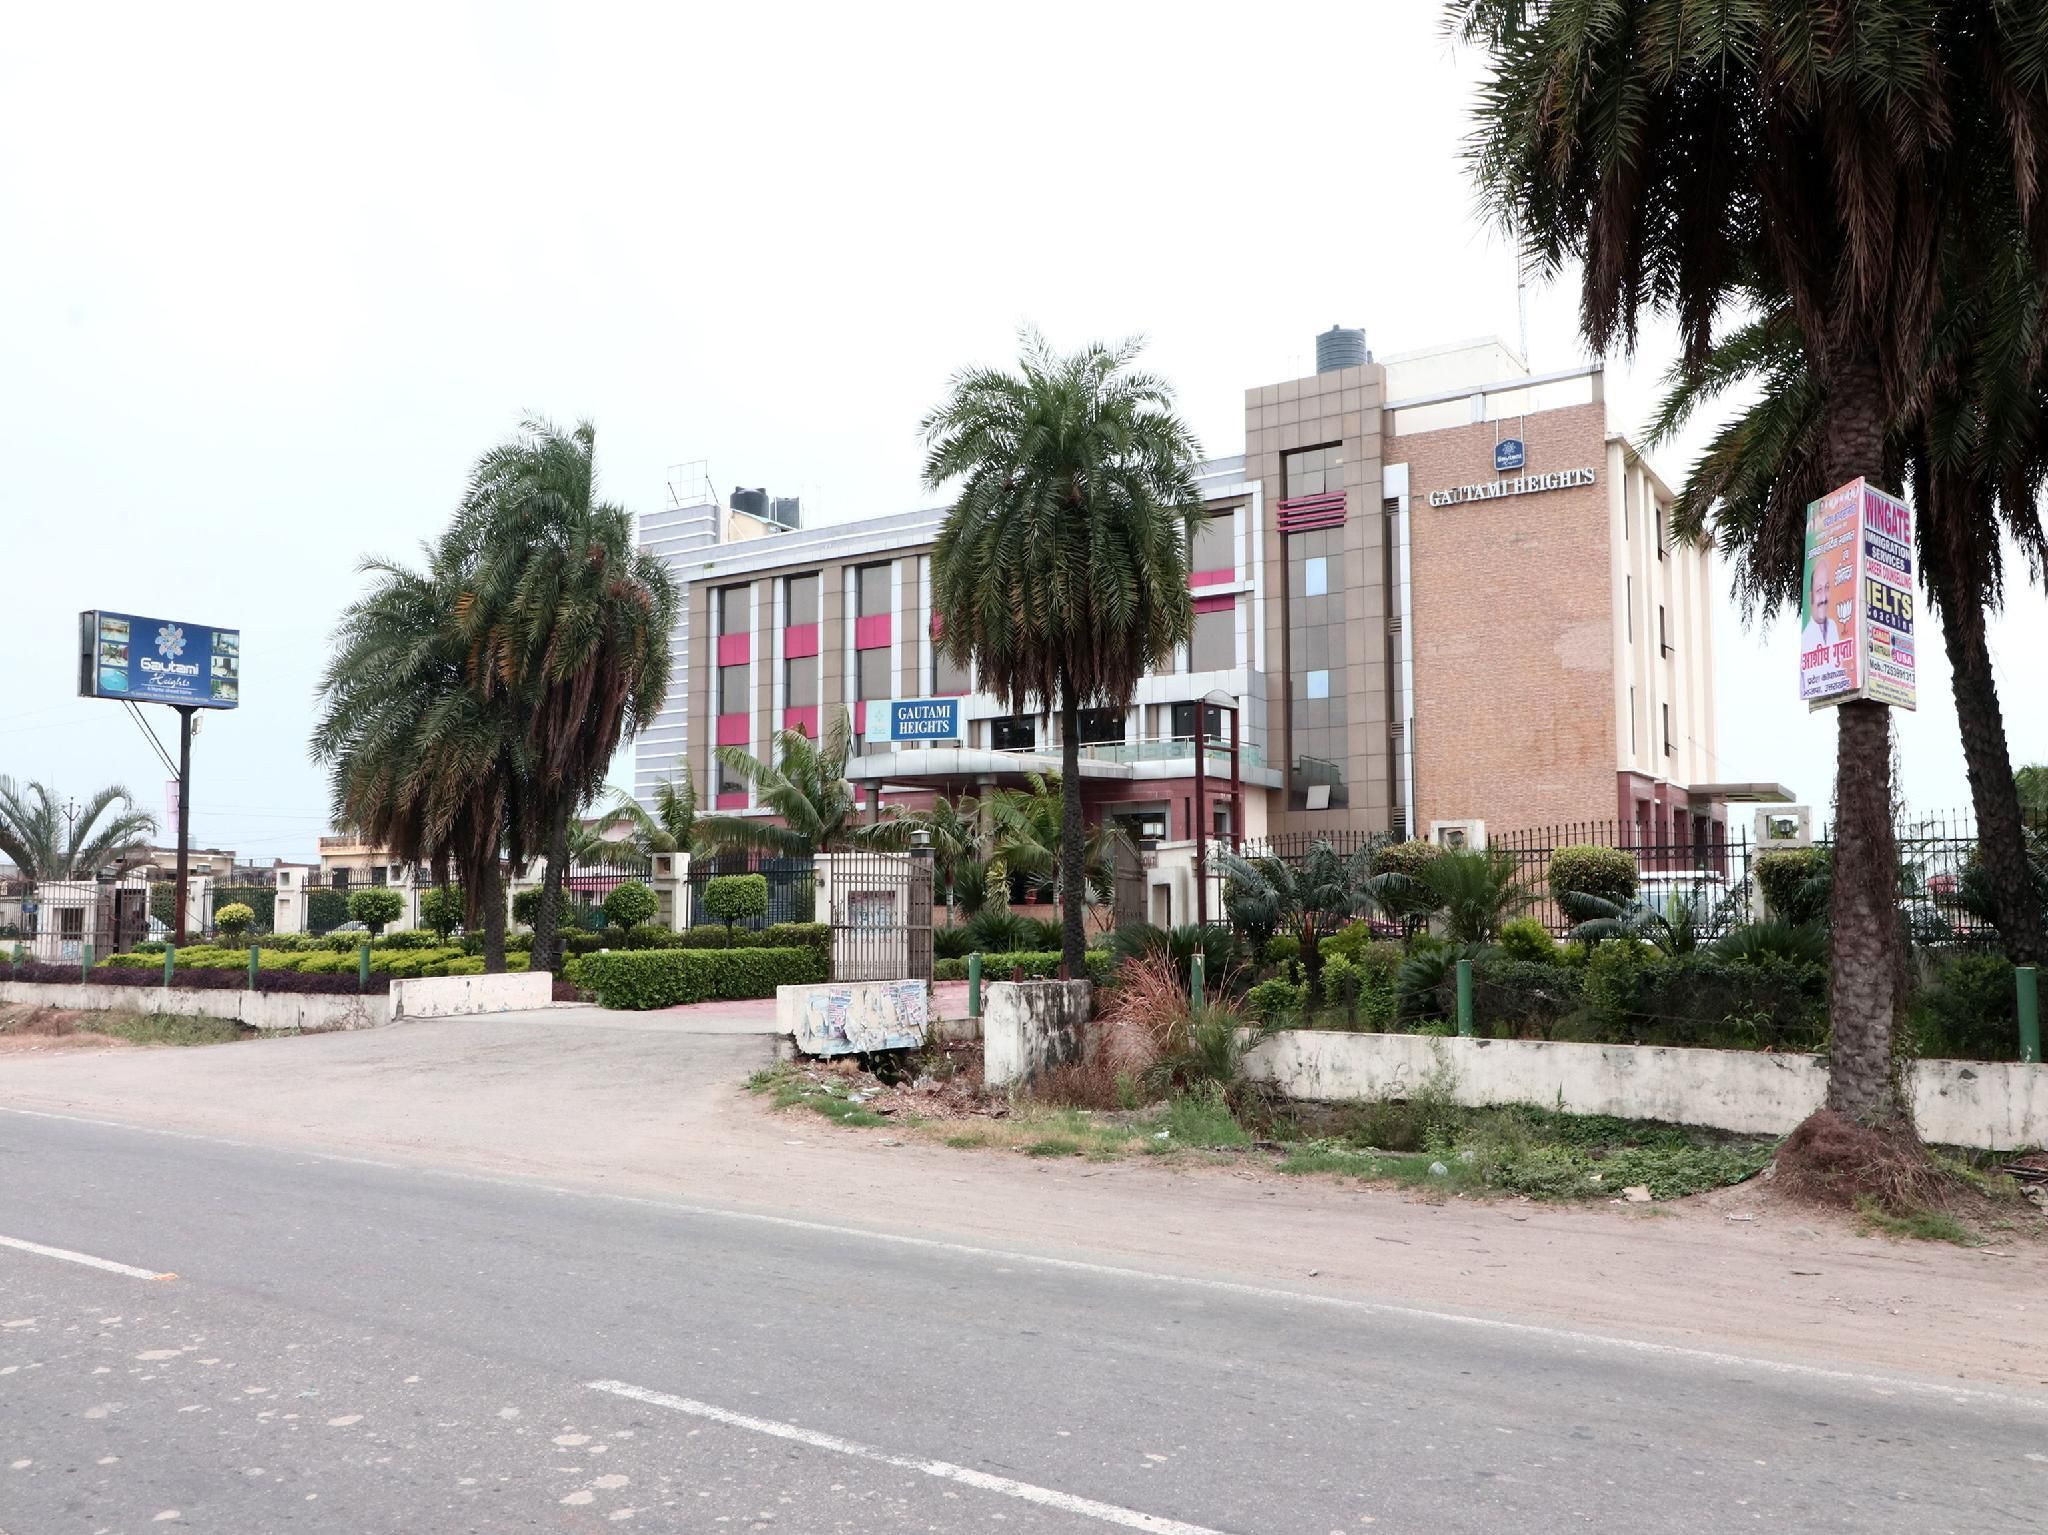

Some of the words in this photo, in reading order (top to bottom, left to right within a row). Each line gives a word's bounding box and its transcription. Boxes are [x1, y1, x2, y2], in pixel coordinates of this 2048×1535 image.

[1429, 480, 1509, 507] GAUTAMI
[1513, 467, 1595, 495] HEIGHTS
[1865, 491, 1911, 544] WINGATE
[1865, 529, 1911, 561] IMMIGRATION
[1871, 545, 1905, 571] SERVICES
[1866, 579, 1912, 620] IELTS
[1867, 603, 1913, 634] Coaching
[140, 657, 199, 675] Gautami
[1802, 644, 1830, 670] आशीष
[1833, 640, 1853, 668] गुप्ता
[1896, 651, 1912, 665] USA
[149, 673, 190, 689] Heights
[898, 705, 951, 720] GAUTAMI
[899, 720, 950, 734] HEIGHTS
